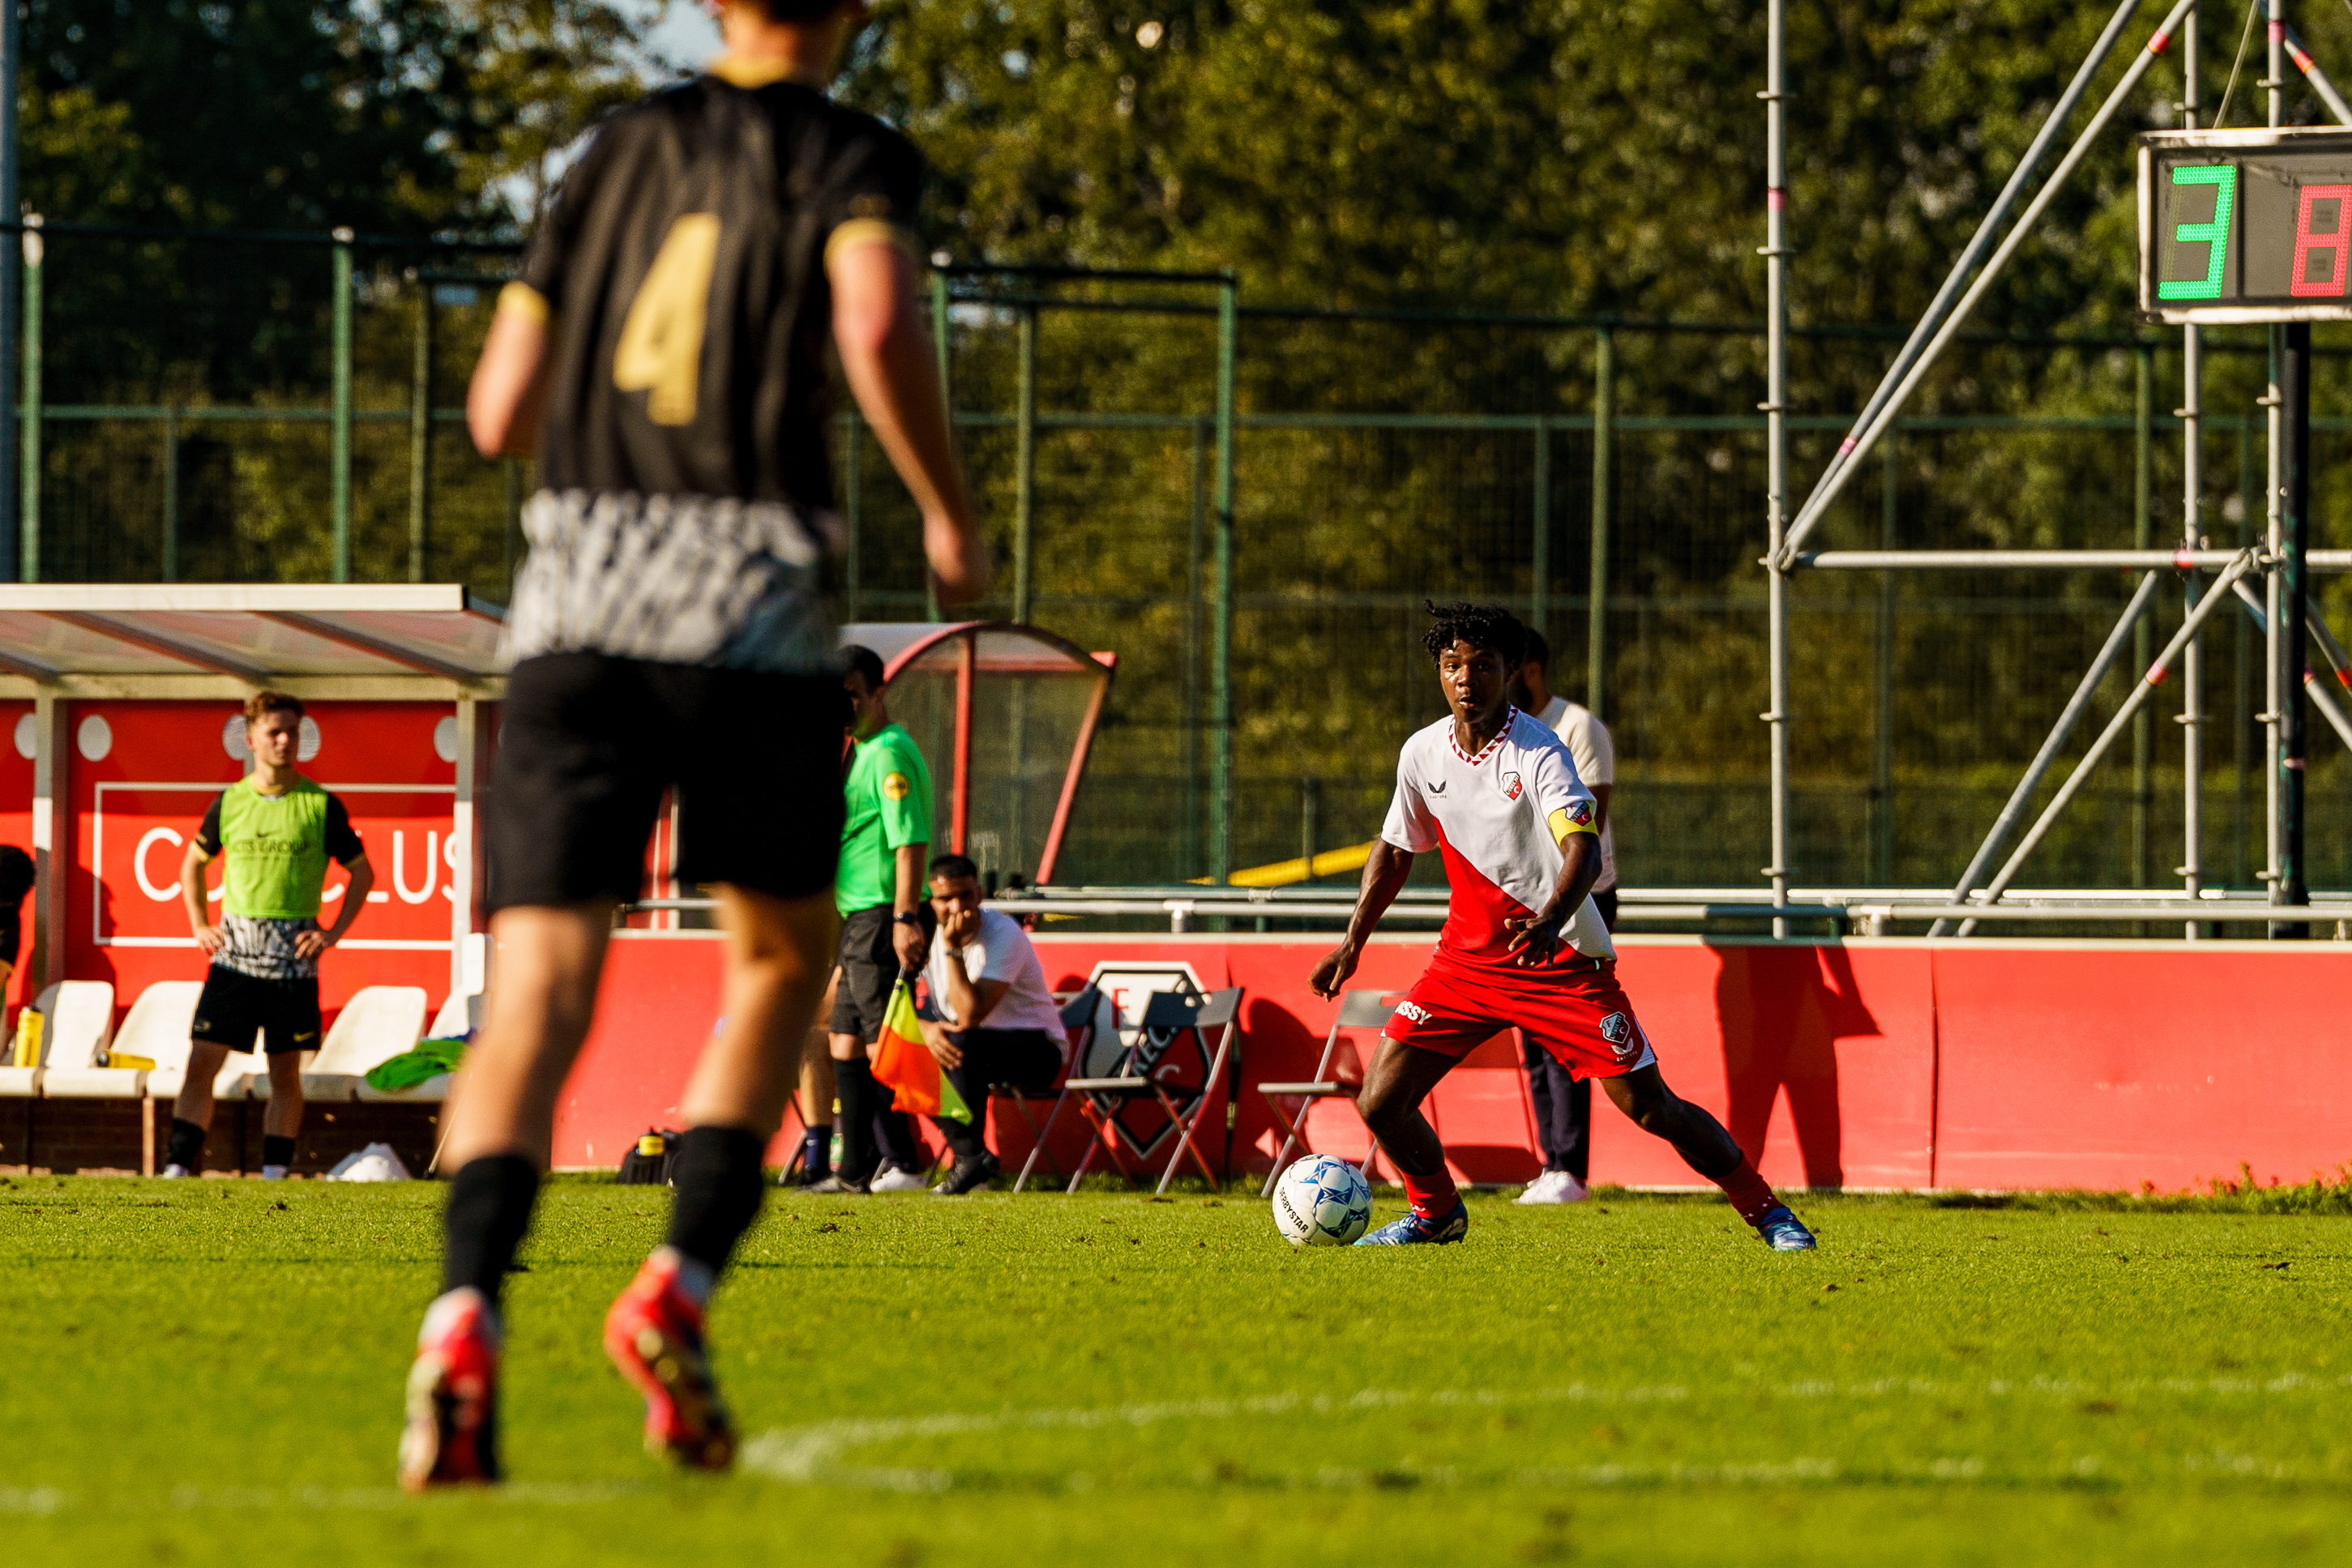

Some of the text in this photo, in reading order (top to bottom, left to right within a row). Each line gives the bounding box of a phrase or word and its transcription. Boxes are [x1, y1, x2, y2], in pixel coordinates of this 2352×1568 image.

[2157, 165, 2352, 300] 3 8
[614, 212, 722, 425] 4
[1280, 1186, 1309, 1233] DERBYSTAR
